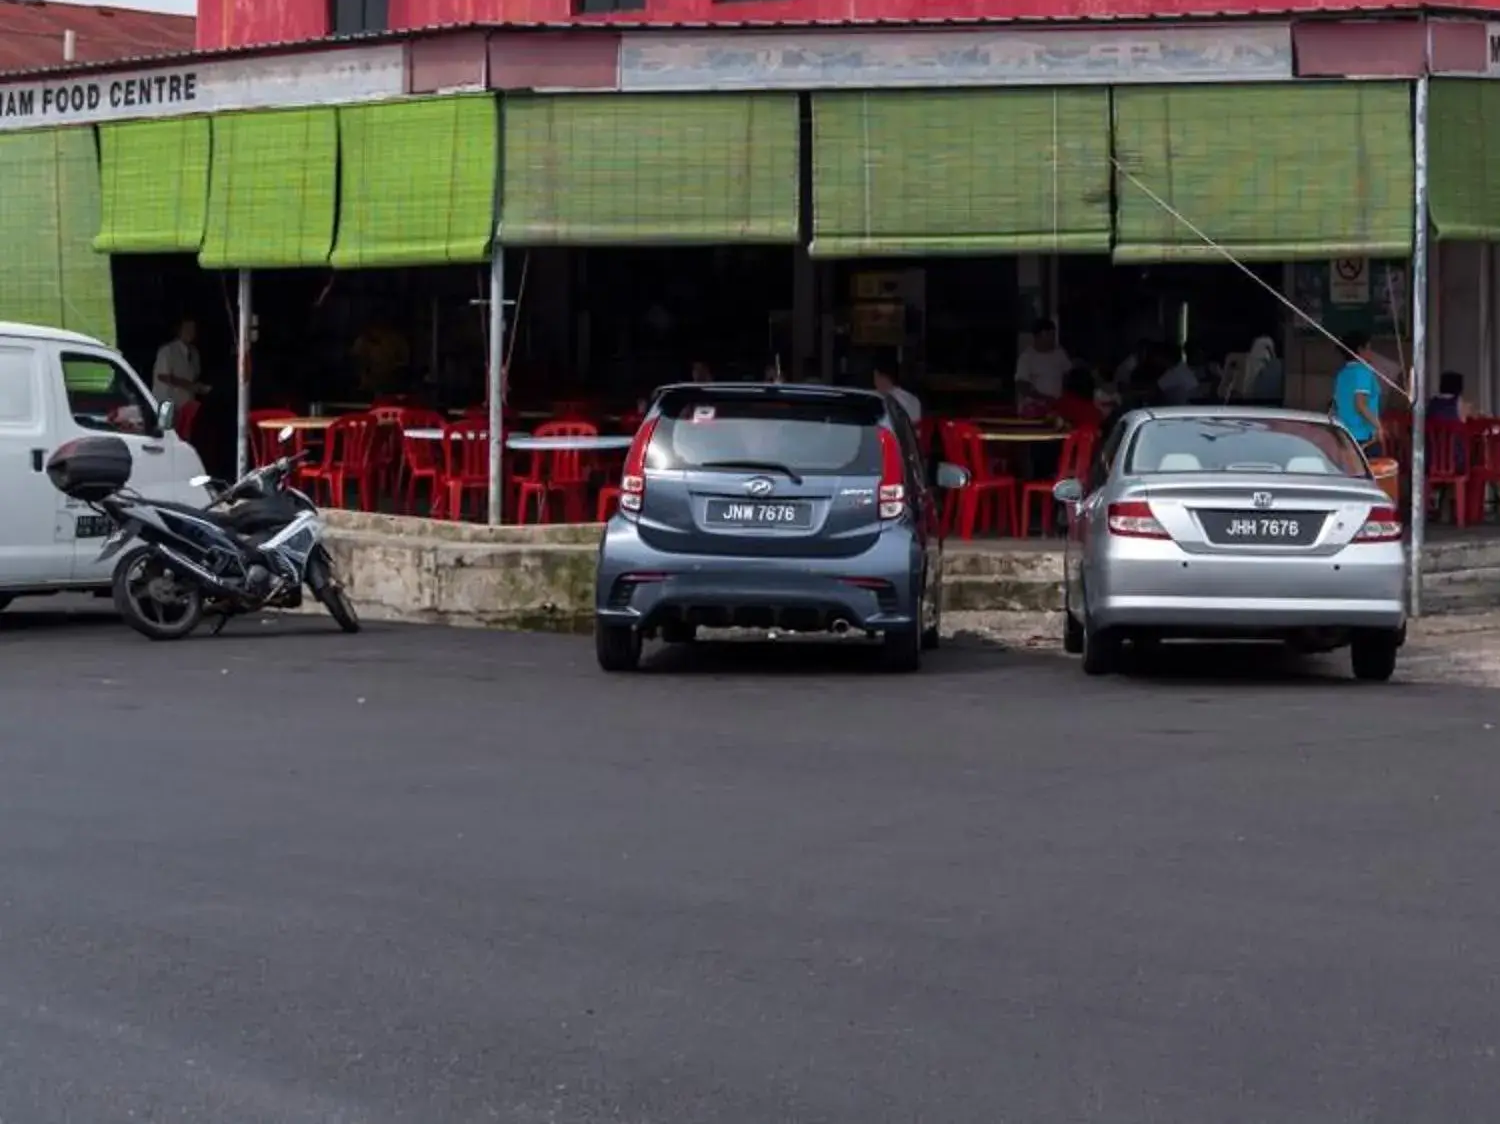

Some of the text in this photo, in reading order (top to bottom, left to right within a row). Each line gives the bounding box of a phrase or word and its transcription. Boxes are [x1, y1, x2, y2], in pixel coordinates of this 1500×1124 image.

[42, 84, 100, 114] FOOD
[109, 73, 197, 108] CENTRE
[722, 504, 796, 522] JNW 7676
[1226, 519, 1299, 536] JHH 7676
